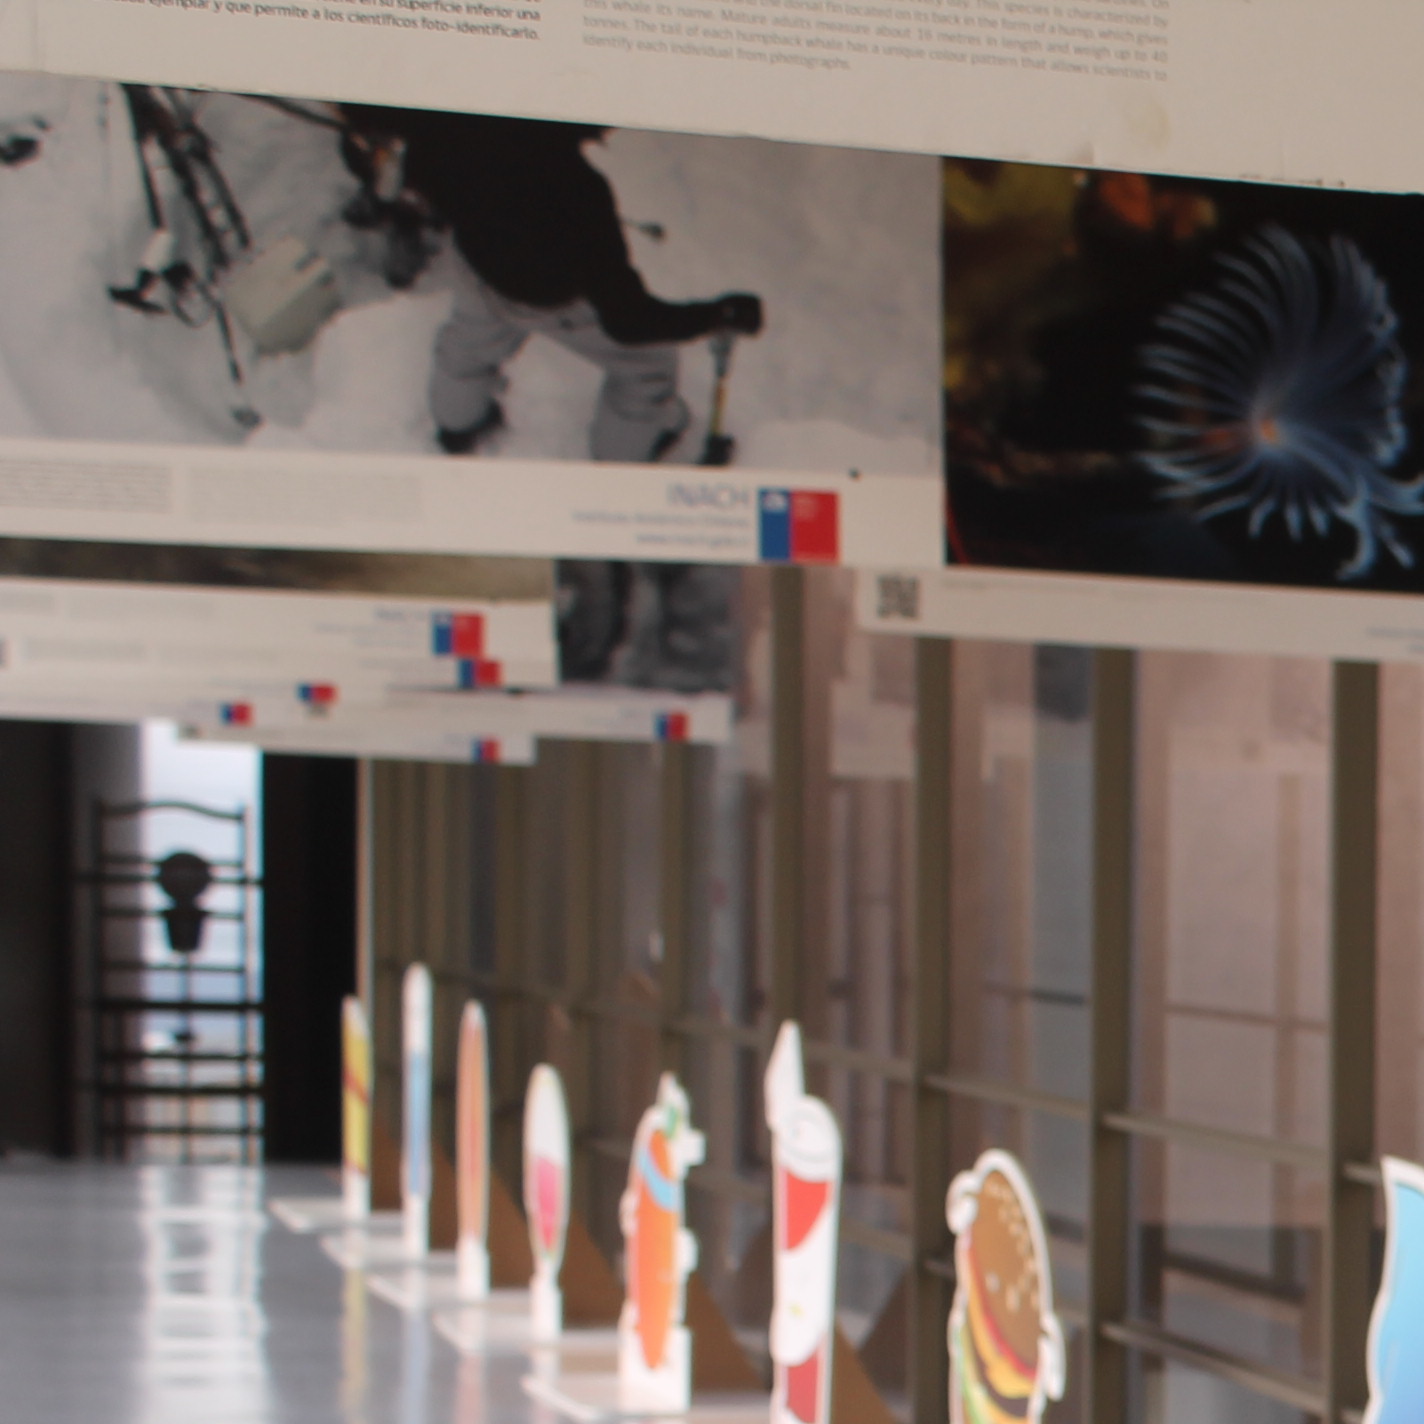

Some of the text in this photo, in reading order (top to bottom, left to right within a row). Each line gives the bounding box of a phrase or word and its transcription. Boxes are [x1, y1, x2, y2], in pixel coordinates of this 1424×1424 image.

[213, 1, 222, 14] y
[225, 2, 251, 14] que
[254, 3, 310, 19] permite
[312, 9, 322, 20] a
[323, 7, 344, 23] los
[347, 10, 417, 29] científicos
[397, 0, 463, 16] superficie
[466, 2, 513, 19] inferior
[516, 9, 541, 22] una
